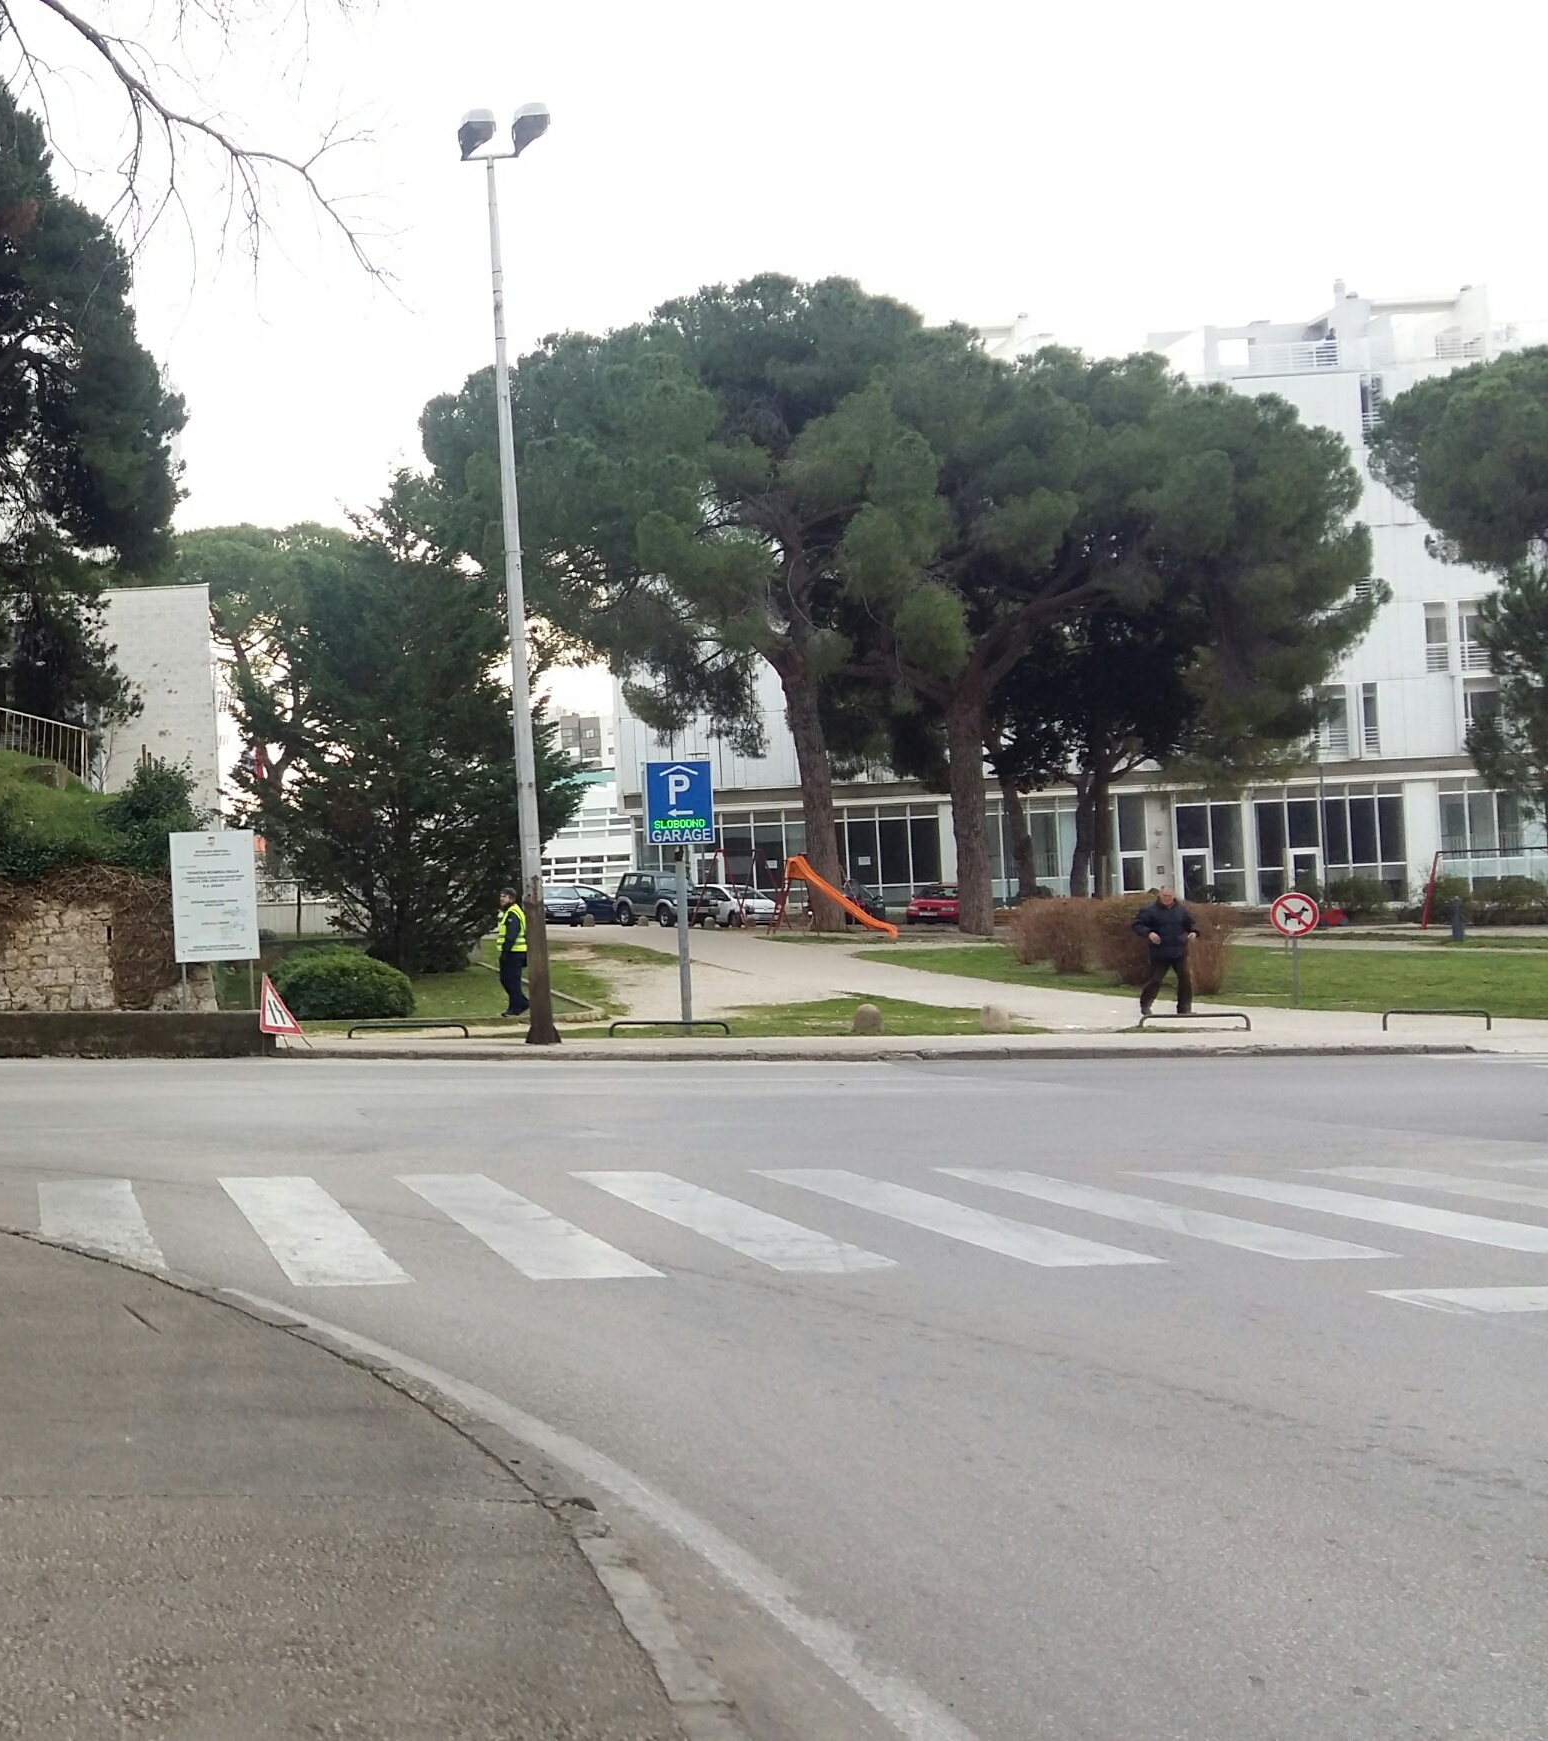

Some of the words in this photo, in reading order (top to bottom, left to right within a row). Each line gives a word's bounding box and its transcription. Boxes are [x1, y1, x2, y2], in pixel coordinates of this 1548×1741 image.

[668, 774, 690, 805] P
[654, 819, 706, 829] SLOBODNO
[652, 828, 711, 842] GARAGE
